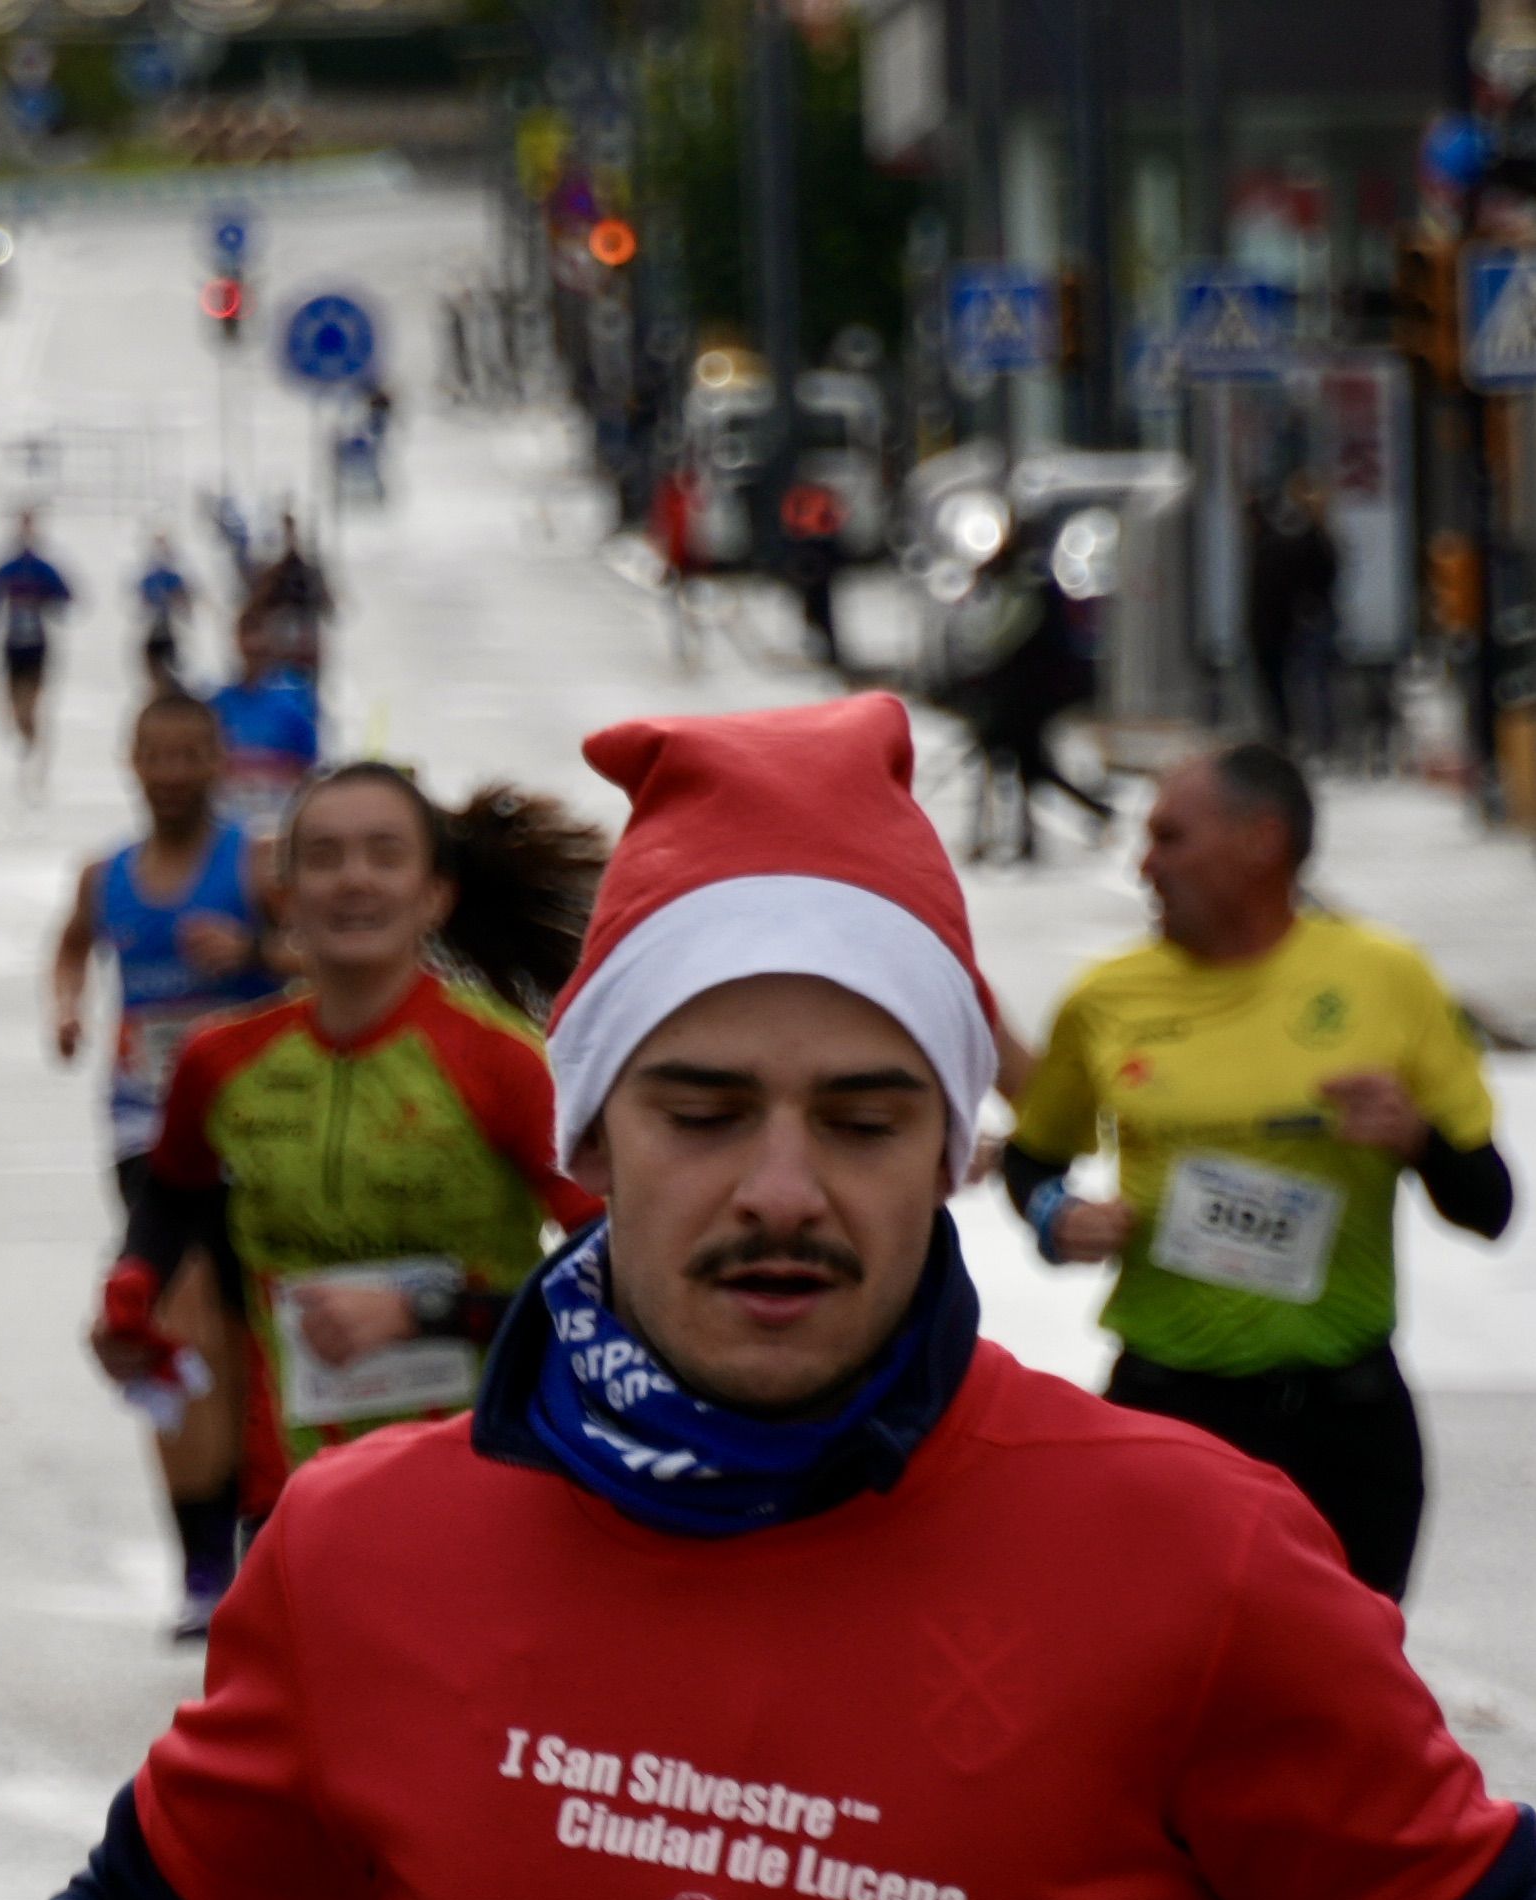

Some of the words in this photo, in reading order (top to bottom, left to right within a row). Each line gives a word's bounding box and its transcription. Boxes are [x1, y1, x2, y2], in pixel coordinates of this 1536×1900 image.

[499, 1727, 530, 1779] I
[533, 1734, 622, 1798] San
[629, 1752, 837, 1839] Silvestre
[557, 1797, 724, 1876] Ciudad
[726, 1834, 791, 1889] de
